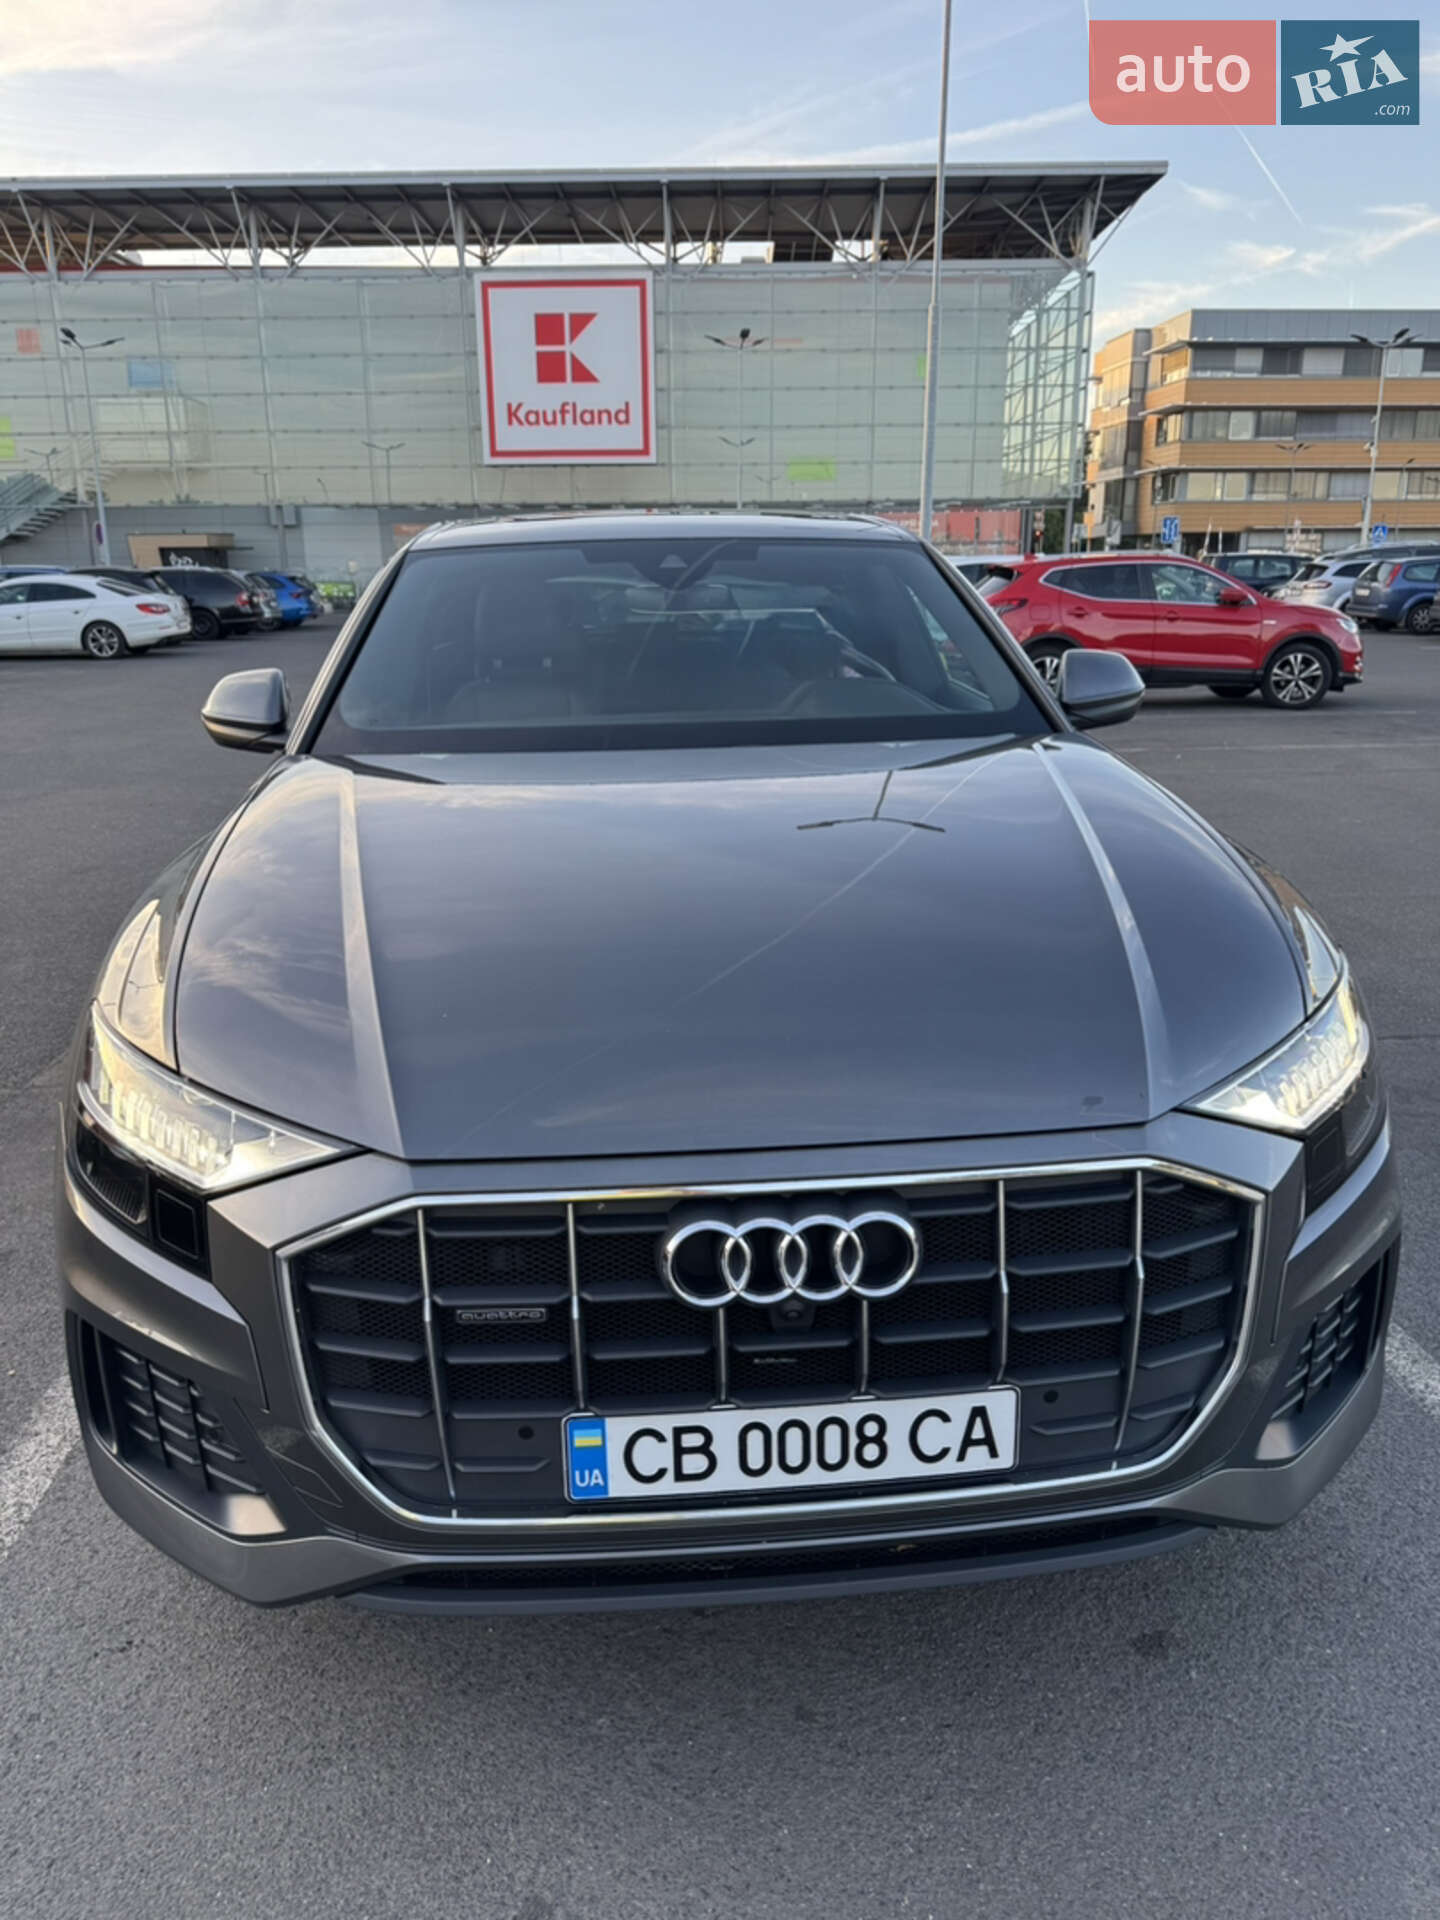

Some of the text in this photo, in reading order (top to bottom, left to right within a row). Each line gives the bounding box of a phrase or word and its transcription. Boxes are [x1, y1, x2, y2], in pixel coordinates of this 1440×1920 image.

[506, 401, 631, 427] Kaufland
[623, 1405, 1000, 1484] CB 0008 CA
[575, 1469, 604, 1488] UA
